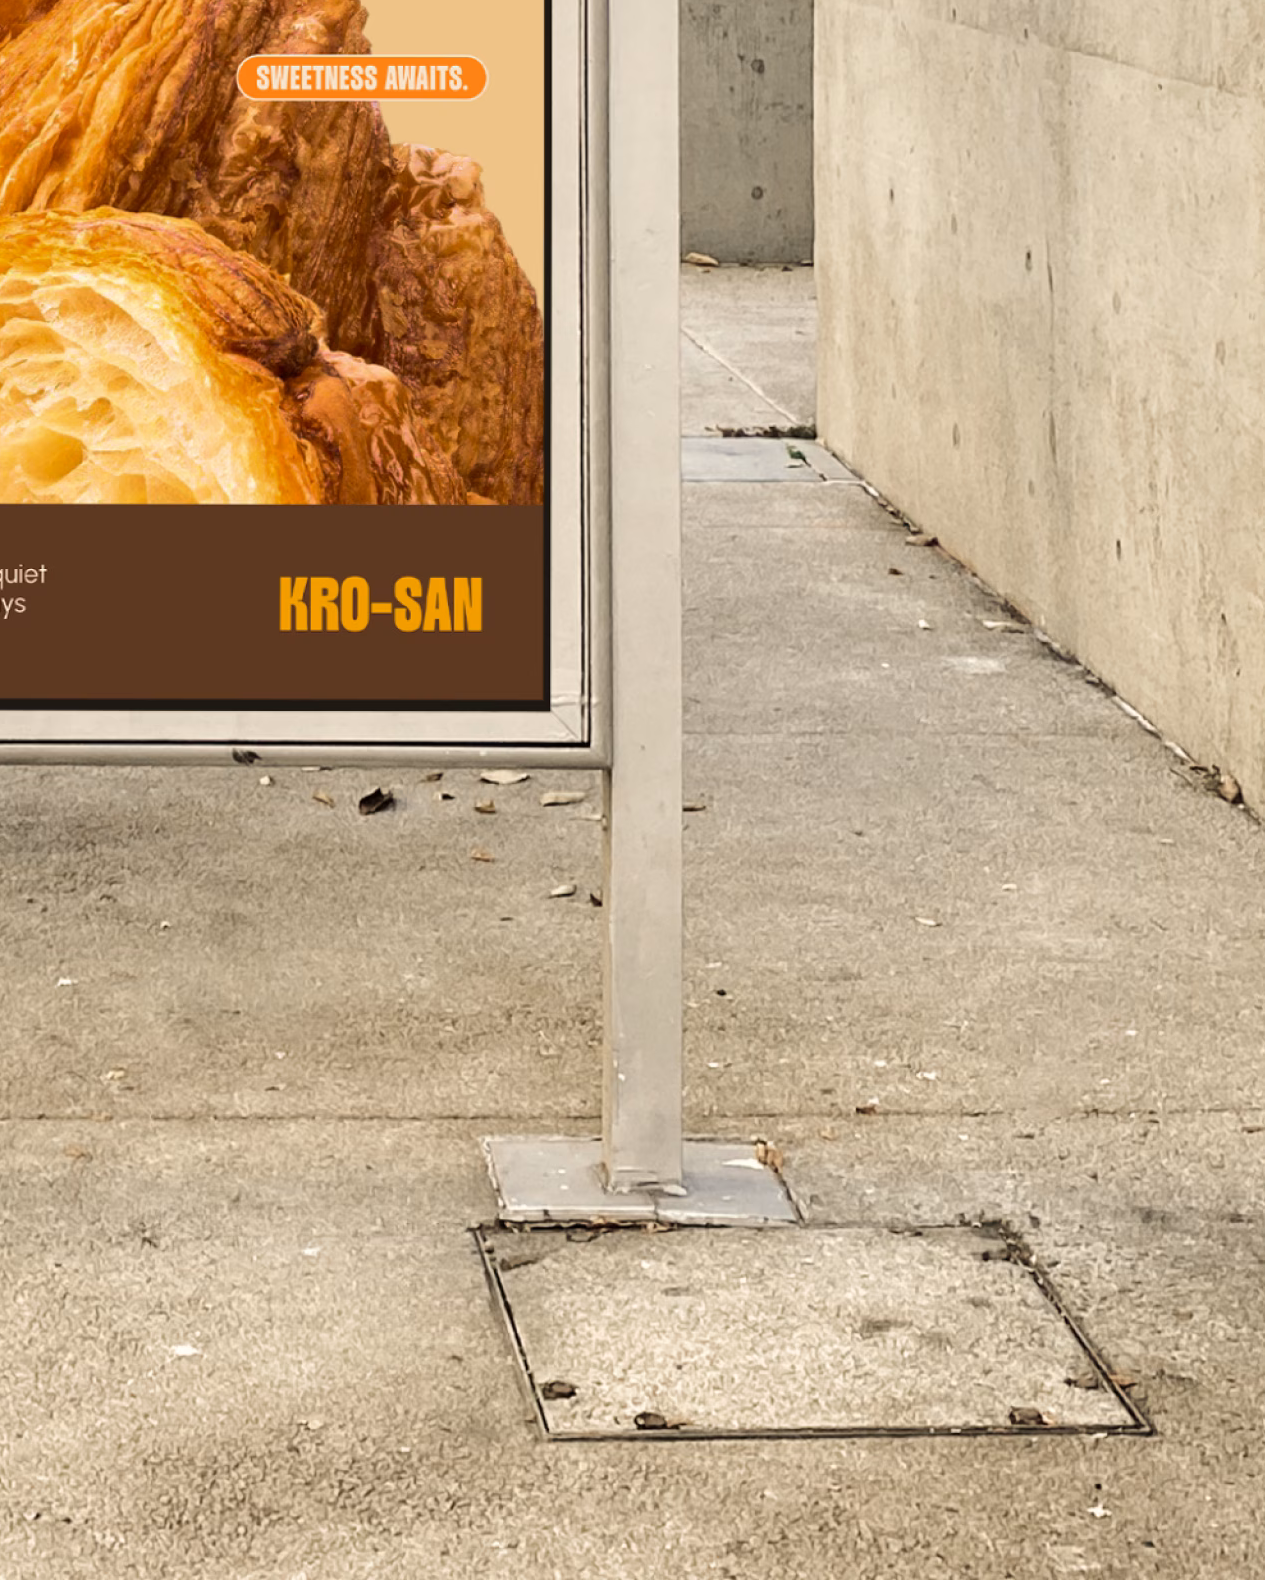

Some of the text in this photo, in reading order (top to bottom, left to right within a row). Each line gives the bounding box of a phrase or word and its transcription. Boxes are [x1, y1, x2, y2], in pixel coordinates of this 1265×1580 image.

[256, 65, 468, 91] SWEETNESS AWAITS.
[279, 575, 482, 633] KRO-SAN
